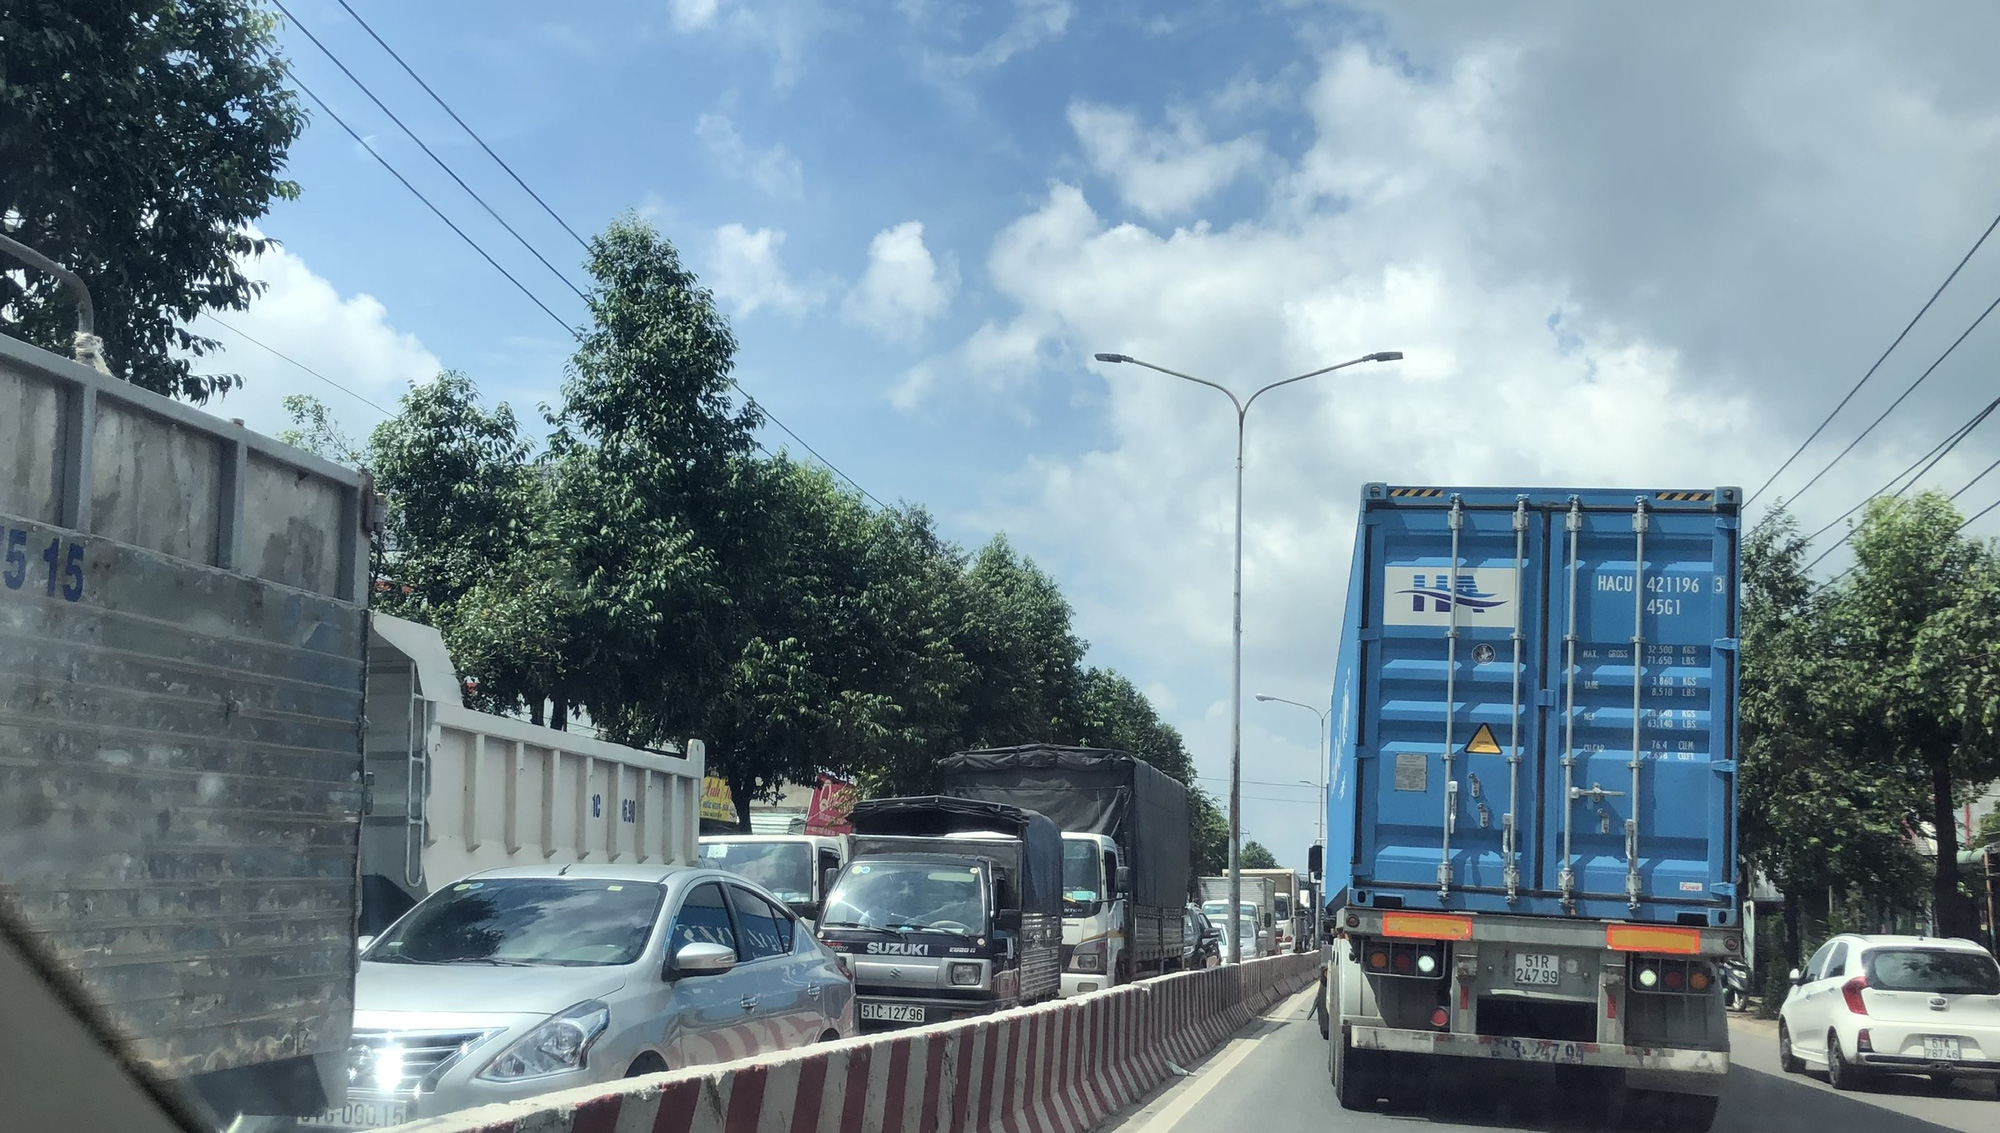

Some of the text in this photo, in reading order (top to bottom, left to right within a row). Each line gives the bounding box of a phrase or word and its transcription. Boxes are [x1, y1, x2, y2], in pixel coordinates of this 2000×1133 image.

[1597, 575, 1724, 593] HACU 421196 3
[1646, 599, 1681, 615] 45G1
[1608, 650, 1628, 658] GROSS
[1647, 645, 1696, 654] 32.500 KGS
[1647, 656, 1696, 665] 71.650 LBS
[1584, 681, 1599, 689] TARE
[1652, 677, 1697, 686] 3.860 KGS
[1651, 688, 1696, 697] 8.510 LBS
[1647, 709, 1696, 718] 28.640 KGS
[1647, 719, 1696, 729] 63.140 LBS
[1651, 740, 1668, 749] 76.4
[866, 941, 929, 956] SUZUKI
[1525, 954, 1549, 969] 51R
[1516, 968, 1558, 983] 247.99
[862, 1004, 923, 1021] 51C-127.96
[1931, 1037, 1951, 1048] 61A
